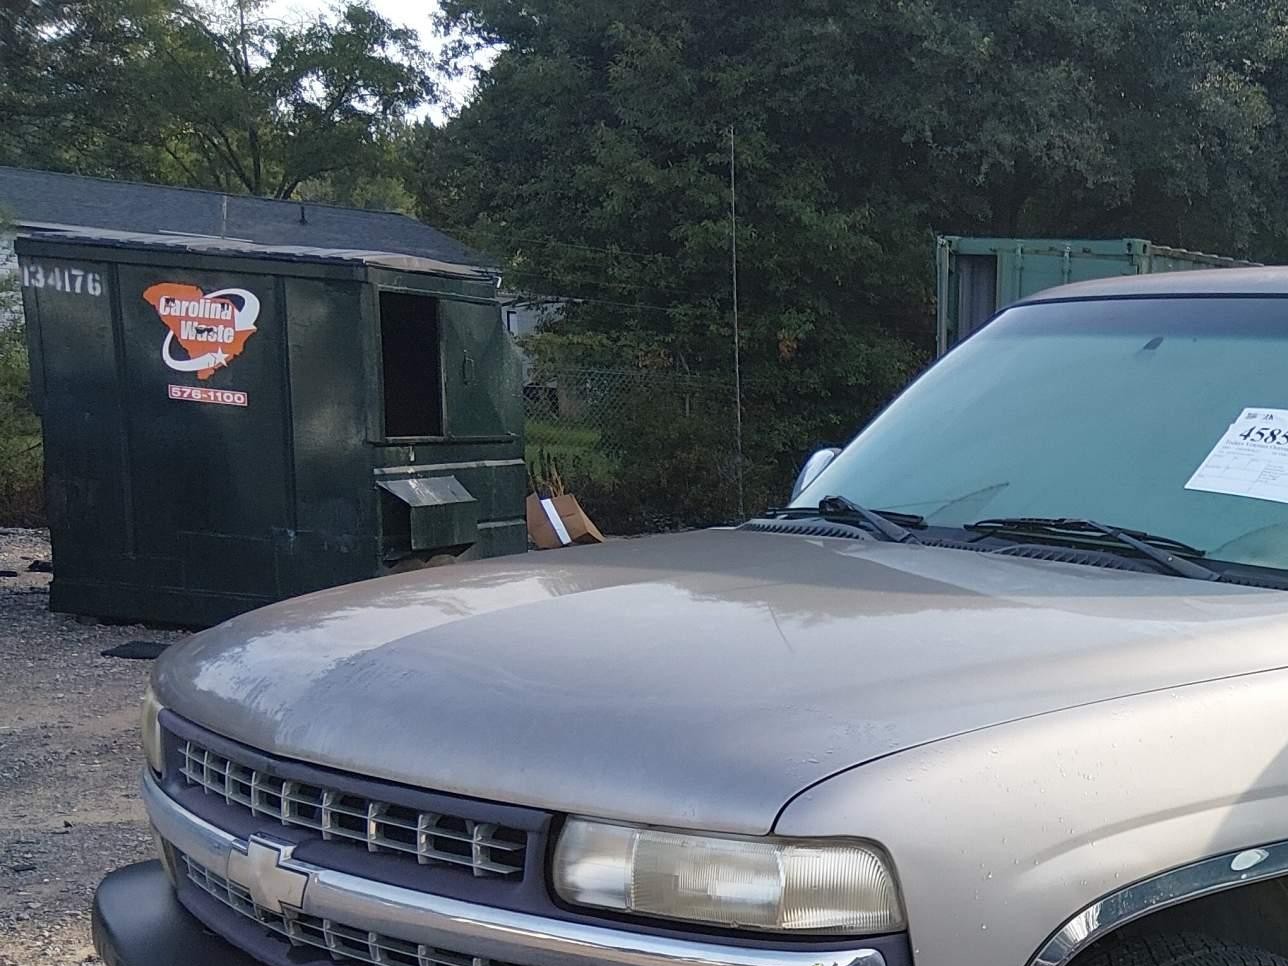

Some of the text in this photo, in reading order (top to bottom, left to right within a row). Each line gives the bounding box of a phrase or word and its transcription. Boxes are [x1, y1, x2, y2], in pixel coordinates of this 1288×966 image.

[22, 265, 102, 297] 134176
[159, 296, 232, 320] Carolina
[181, 319, 235, 344] Waste
[171, 387, 246, 405] 576-1100
